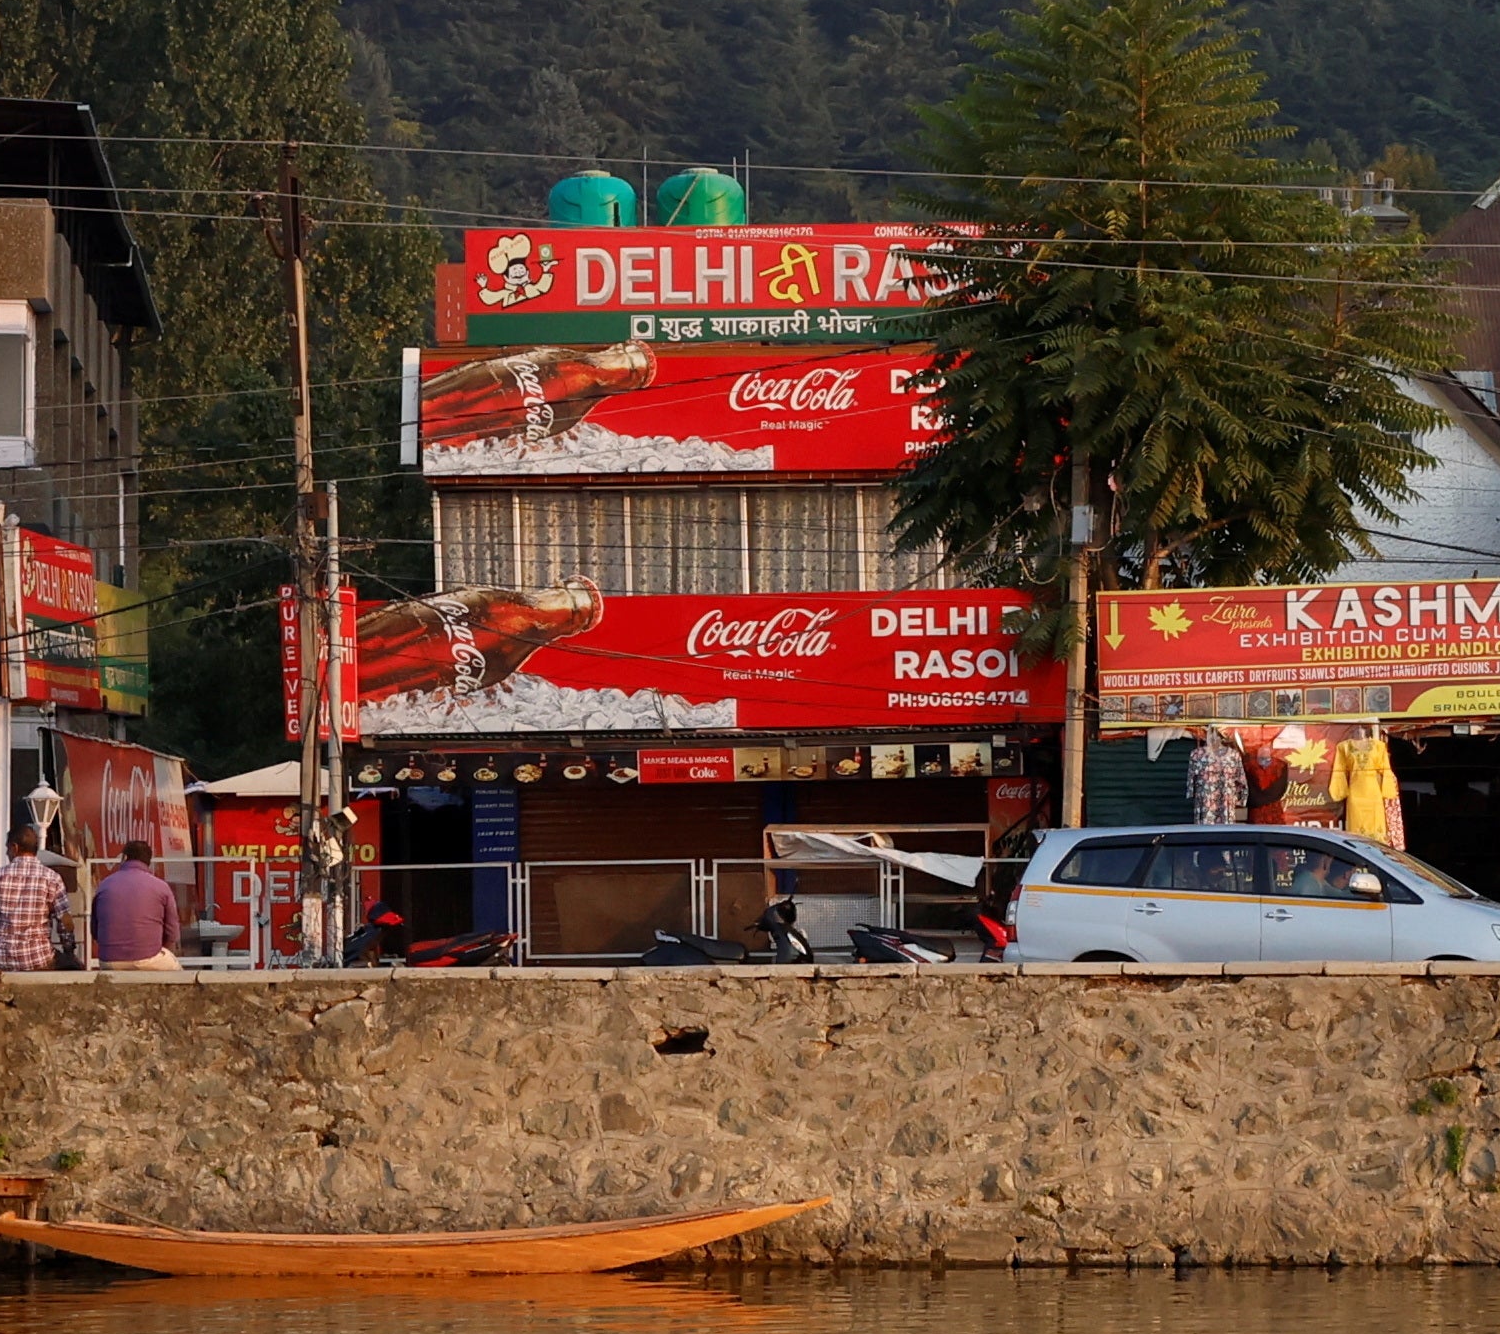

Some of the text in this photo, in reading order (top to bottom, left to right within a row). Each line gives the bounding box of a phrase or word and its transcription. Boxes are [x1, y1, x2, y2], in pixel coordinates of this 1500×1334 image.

[576, 246, 753, 306] DELHI
[759, 243, 819, 303] दी
[660, 314, 702, 339] शुद्ध
[711, 311, 809, 339] शाकाहारी
[729, 368, 861, 411] Coca-Cola
[871, 607, 987, 637] DELHI
[1202, 596, 1257, 624] Zaira
[686, 608, 838, 658] Coca-Cola
[1230, 616, 1273, 633] presents
[1240, 629, 1383, 648] EXHIBITION
[1396, 626, 1446, 642] CUM
[894, 648, 1019, 679] RASOI
[1302, 645, 1401, 662] EXHIBITION
[1409, 644, 1429, 659] OF
[1103, 674, 1140, 688] WOOLEN
[1143, 672, 1181, 686] CARPETS
[1183, 671, 1203, 685] SILK
[1205, 670, 1244, 684] CARPETS
[1249, 668, 1298, 683] DRYFRUITS
[1300, 667, 1335, 681] SHAWLS
[668, 756, 694, 764] MEALS
[695, 755, 730, 763] MAGICAL
[221, 845, 302, 864] WELCO
